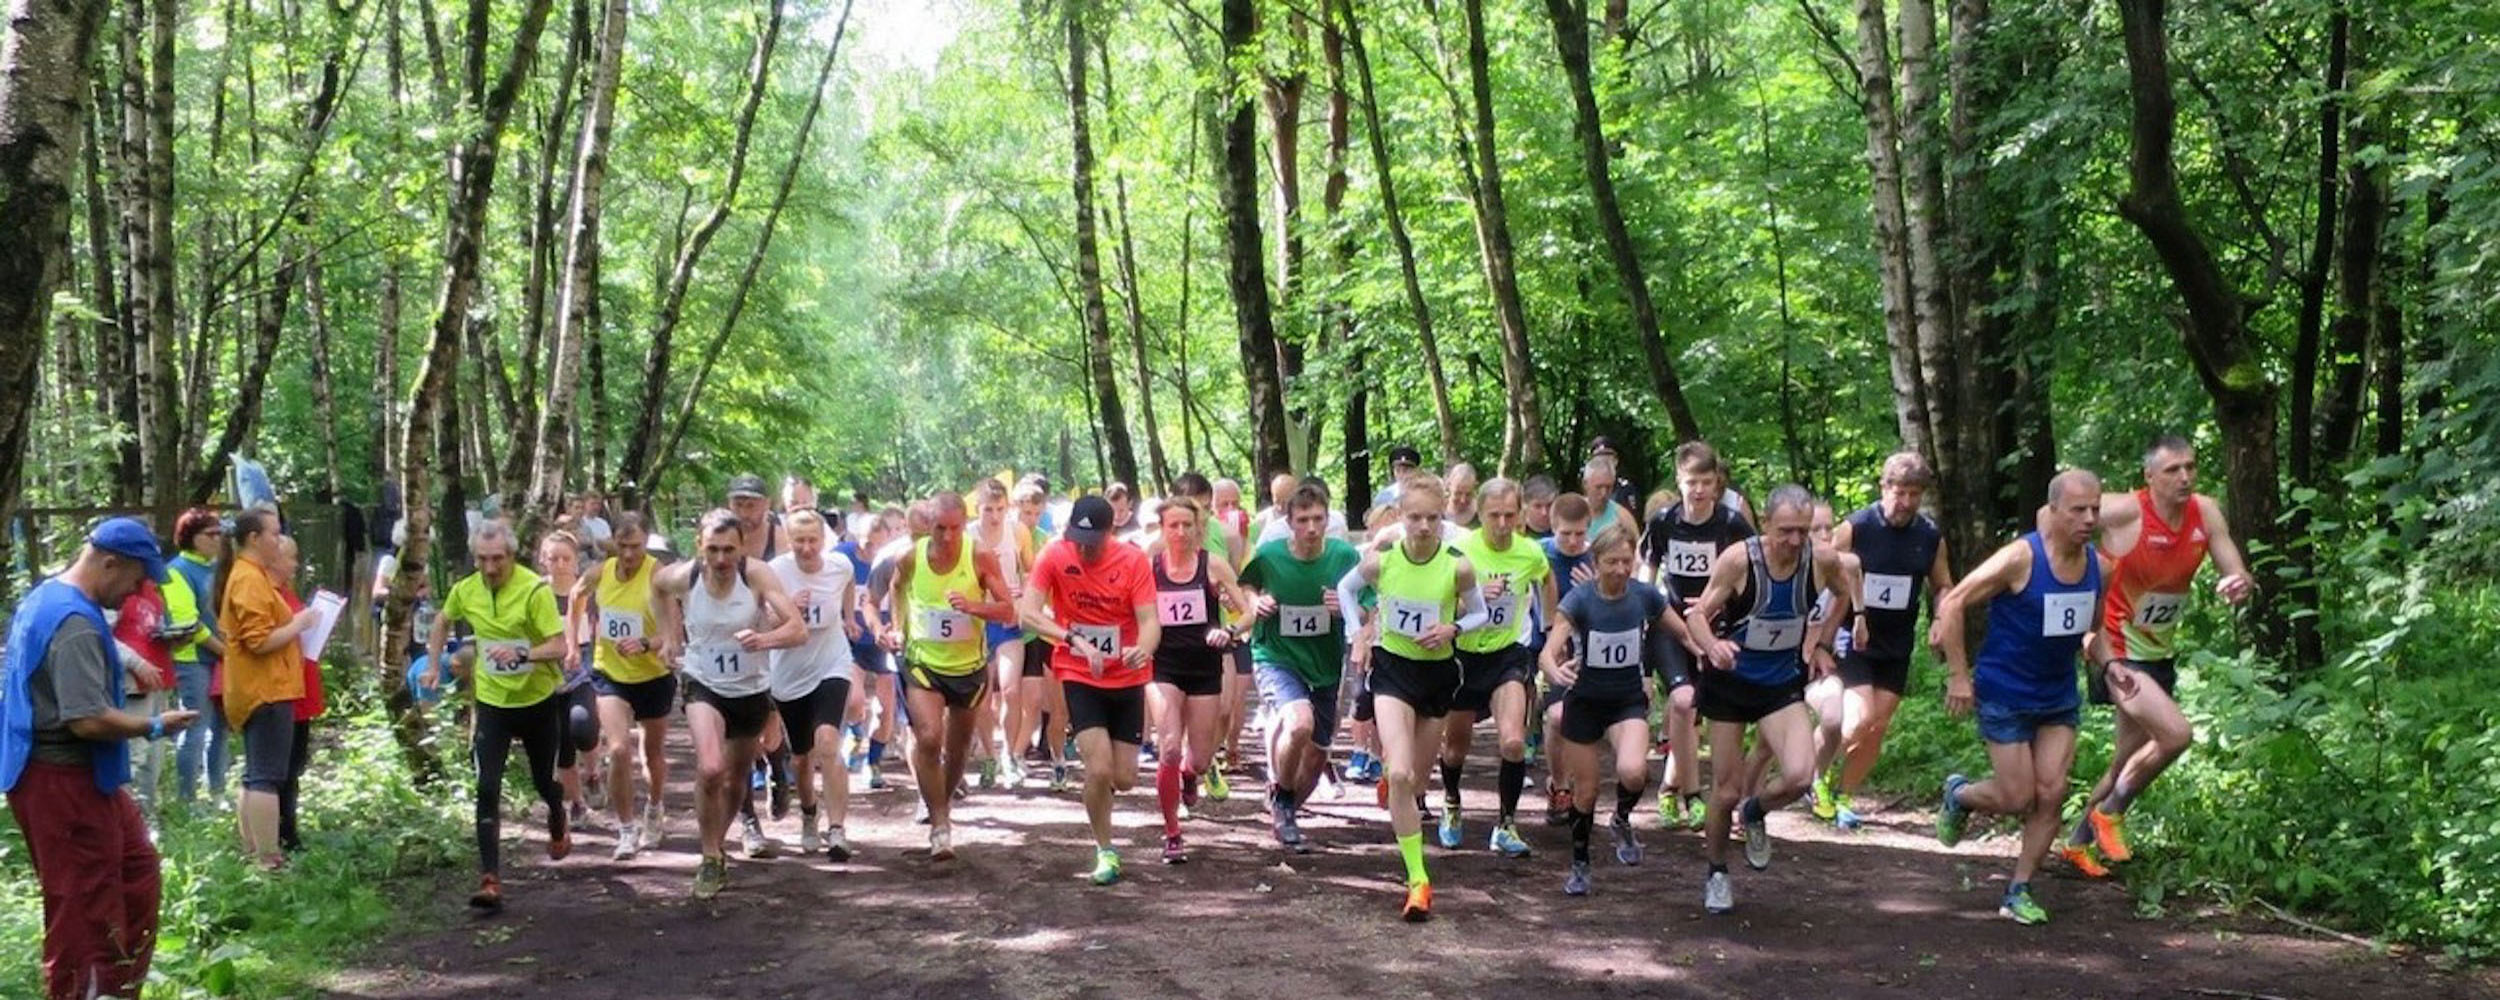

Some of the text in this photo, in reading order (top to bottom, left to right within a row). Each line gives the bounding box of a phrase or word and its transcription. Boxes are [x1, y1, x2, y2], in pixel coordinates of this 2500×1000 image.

[1674, 555, 1708, 572] 123
[1880, 588, 1890, 604] 4
[1169, 603, 1192, 621] 12
[1398, 609, 1422, 633] 71
[2063, 607, 2075, 630] 8
[2143, 603, 2178, 624] 122
[940, 619, 953, 638] 5
[1293, 617, 1316, 633] 14
[1769, 630, 1781, 647] 7
[714, 653, 738, 673] 11
[1601, 644, 1625, 663] 10
